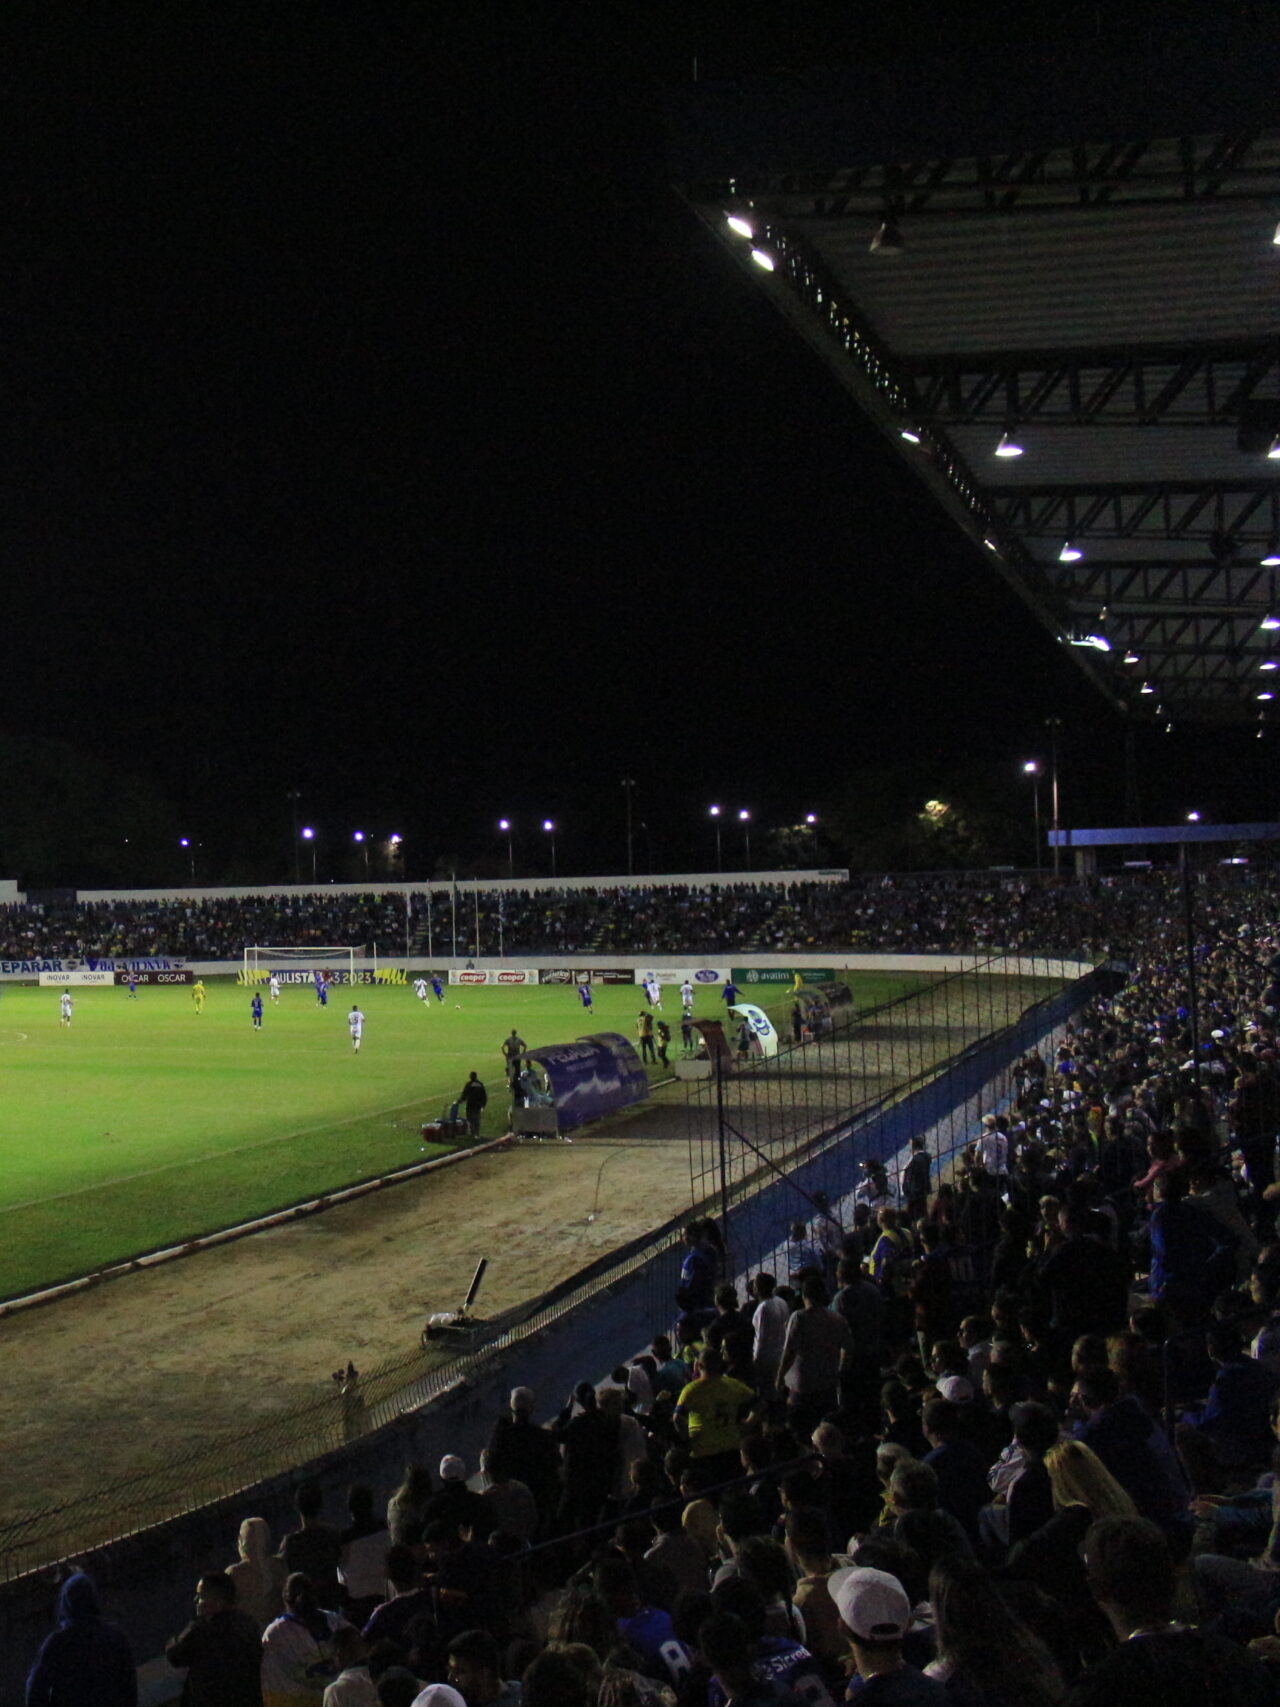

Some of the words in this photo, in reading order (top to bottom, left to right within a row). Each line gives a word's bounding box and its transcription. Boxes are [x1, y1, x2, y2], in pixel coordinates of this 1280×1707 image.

[157, 973, 186, 982] OSCAR
[343, 972, 371, 984] 2023
[460, 974, 486, 983] cooper
[498, 974, 524, 983] cooper
[761, 972, 789, 980] avatim
